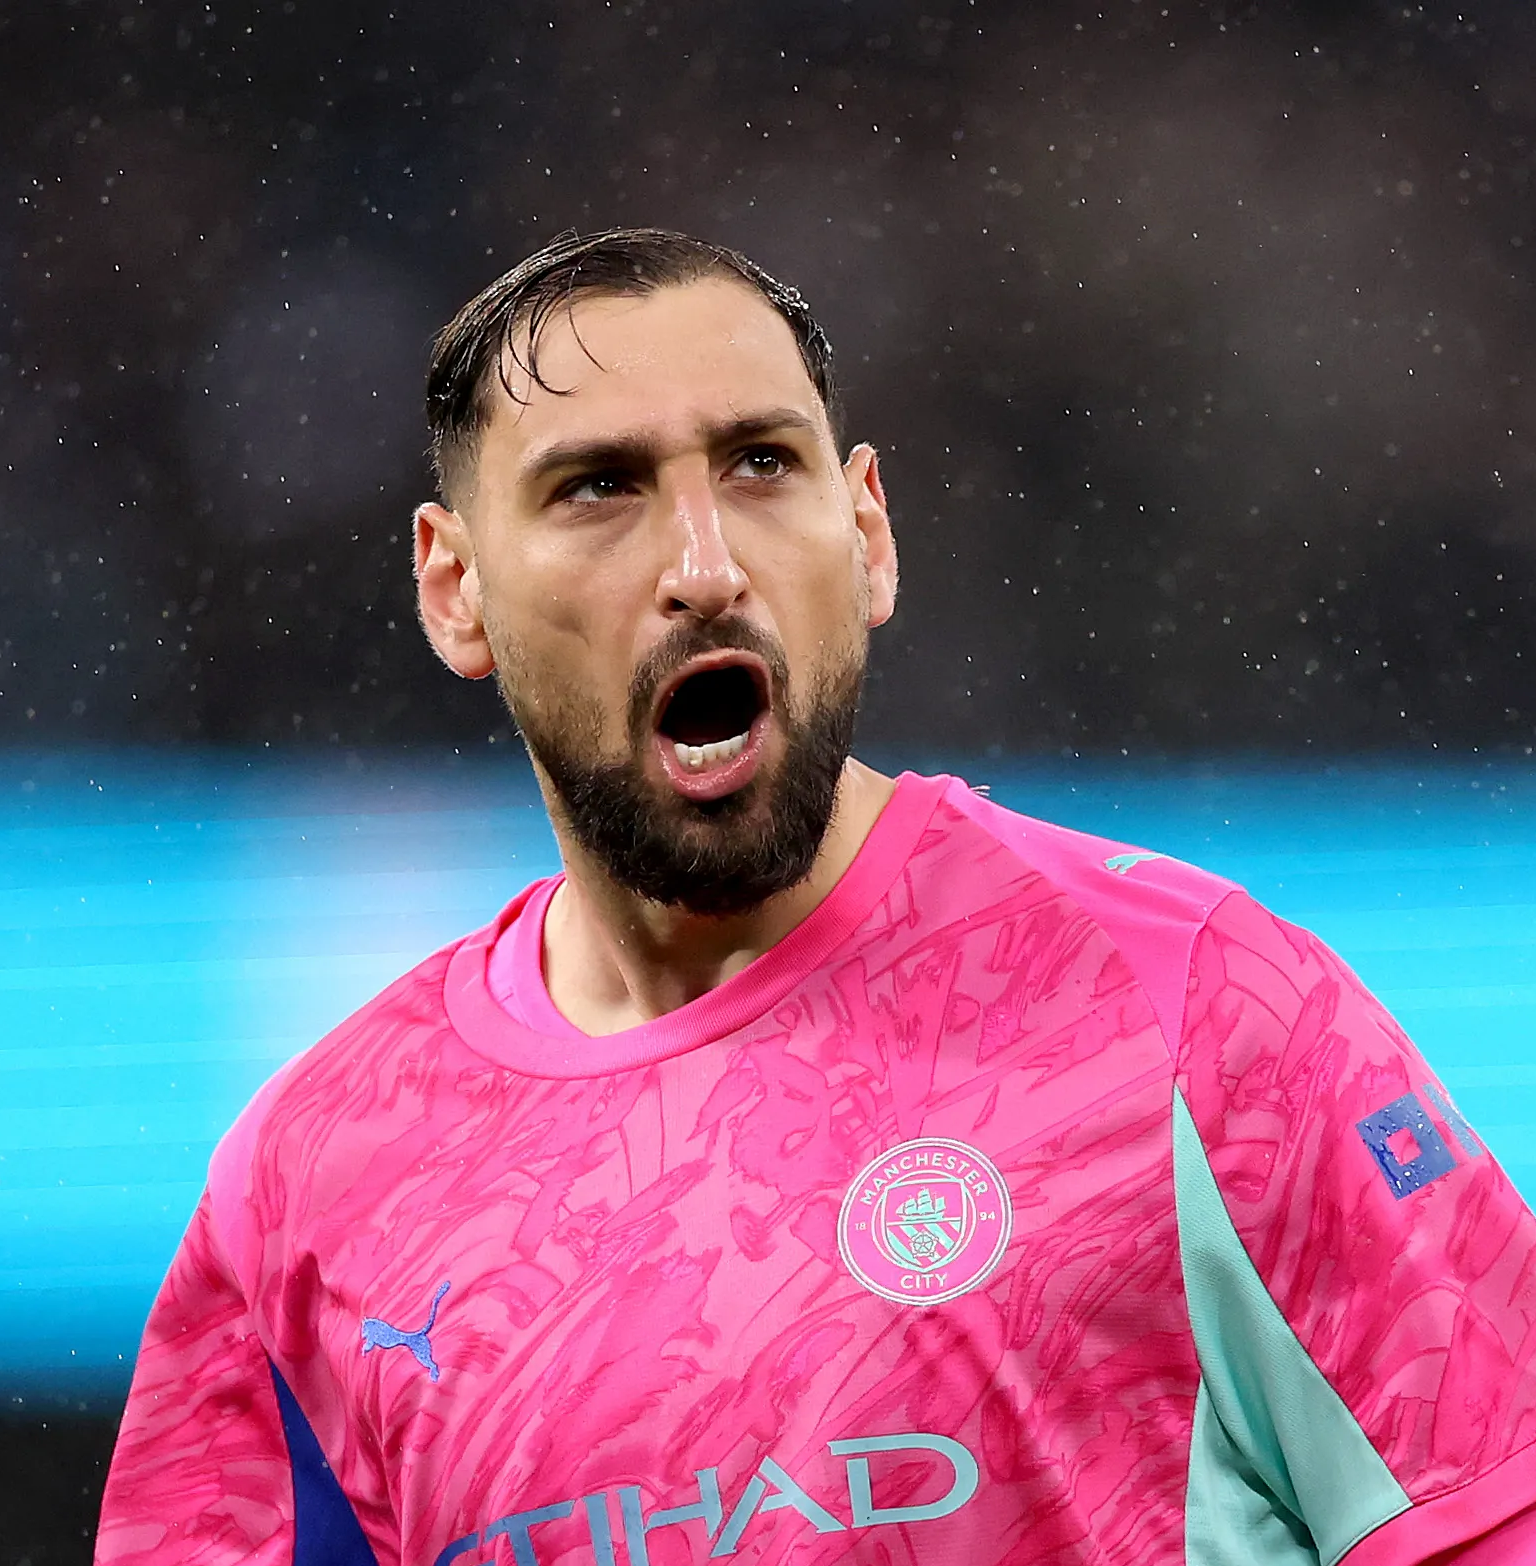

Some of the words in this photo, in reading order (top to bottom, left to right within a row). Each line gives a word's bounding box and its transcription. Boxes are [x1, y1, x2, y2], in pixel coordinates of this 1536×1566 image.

[859, 1152, 989, 1206] MANCHESTER
[854, 1222, 867, 1231] 18
[979, 1211, 996, 1221] 94
[900, 1273, 948, 1289] CITY
